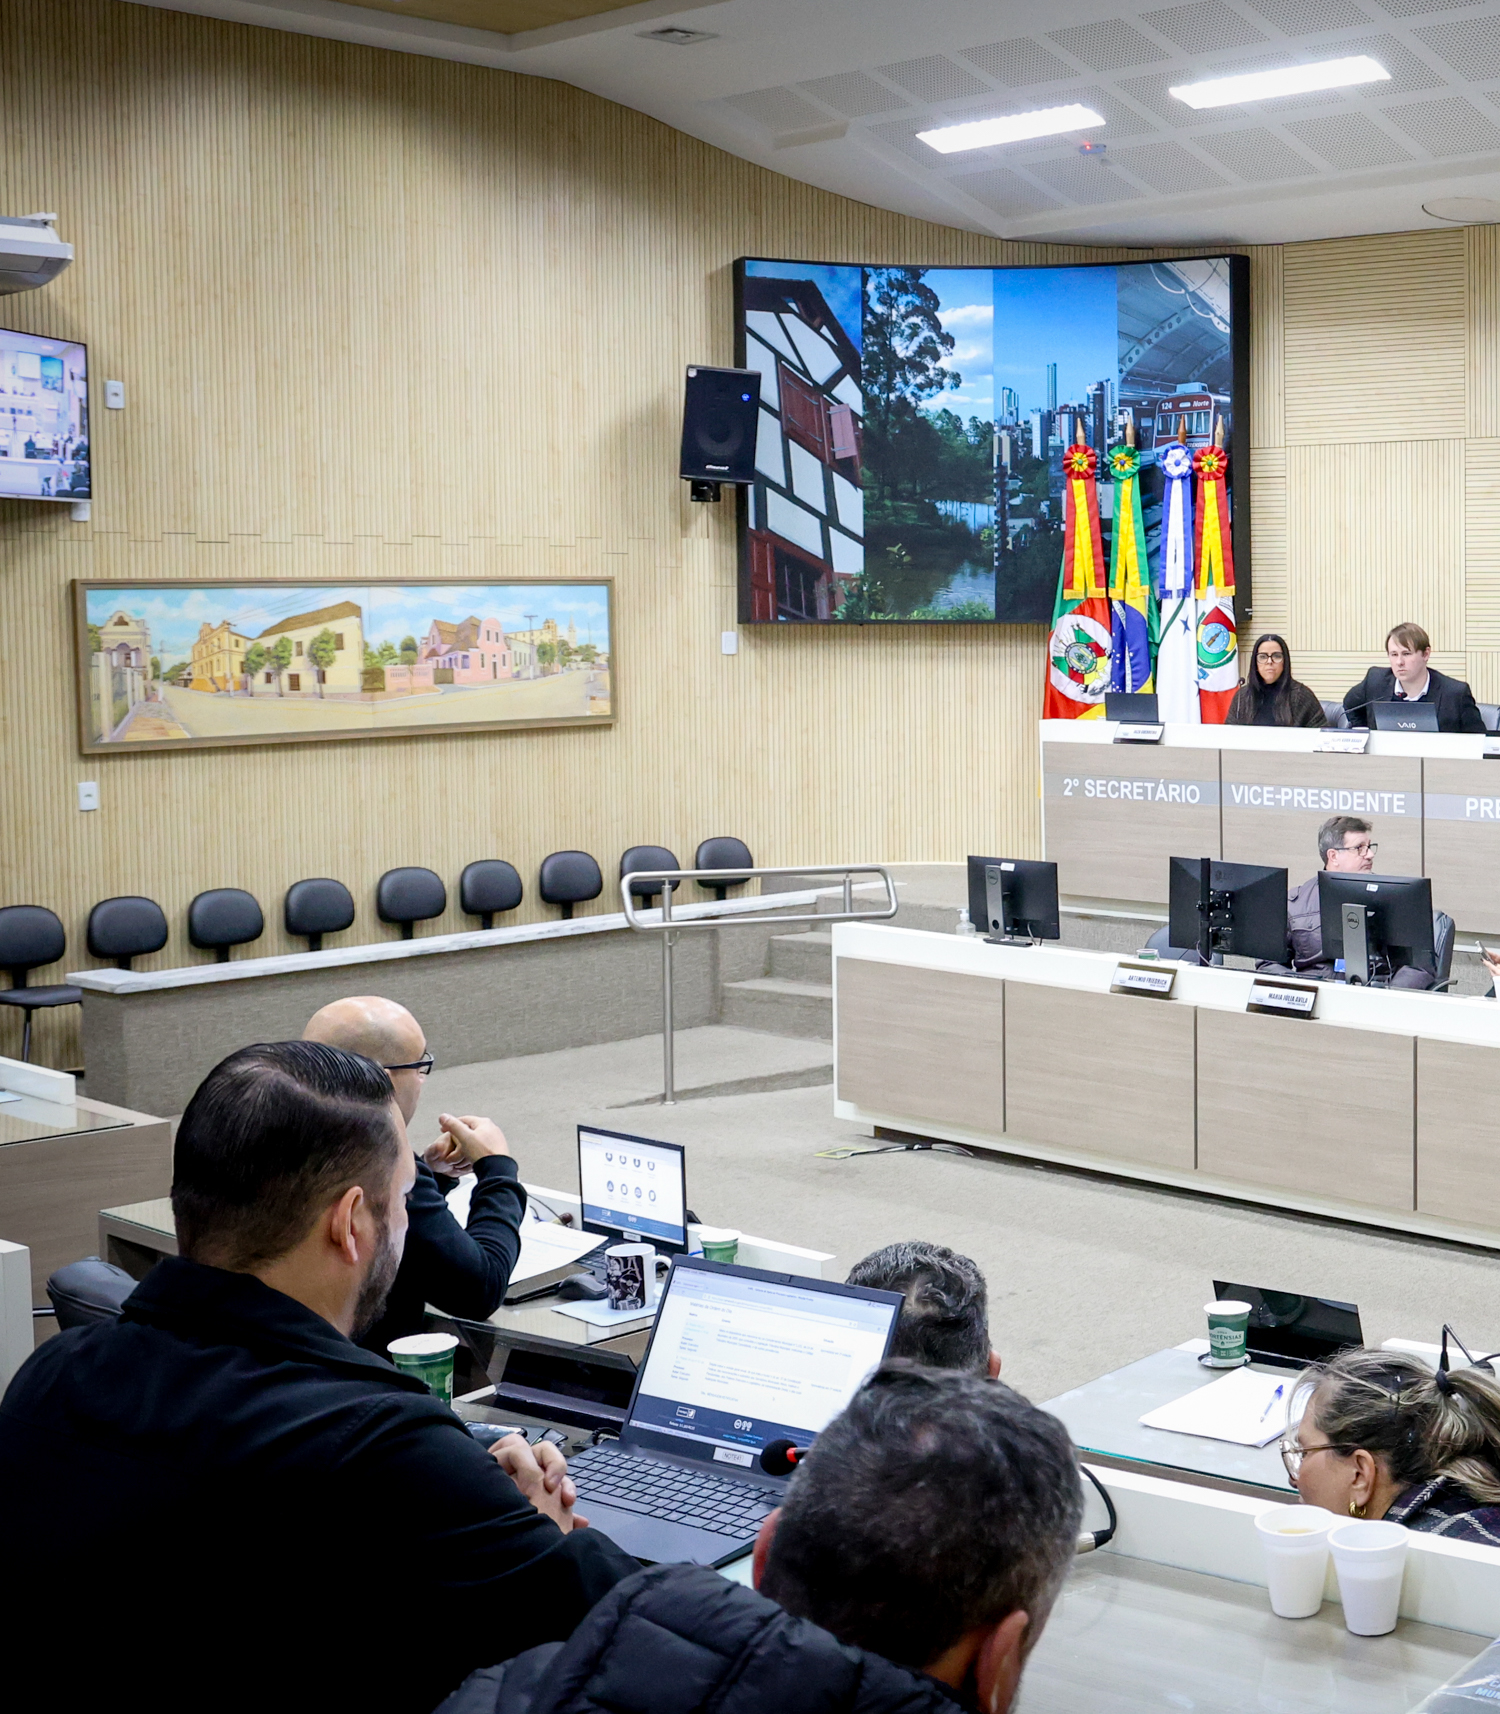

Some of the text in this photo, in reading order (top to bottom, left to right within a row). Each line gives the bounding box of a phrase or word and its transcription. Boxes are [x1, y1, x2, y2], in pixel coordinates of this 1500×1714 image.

[1161, 400, 1210, 410] 124 Norte
[1084, 779, 1201, 804] SECRETÁRIO
[1231, 784, 1406, 814] VICE-PRESIDENTE
